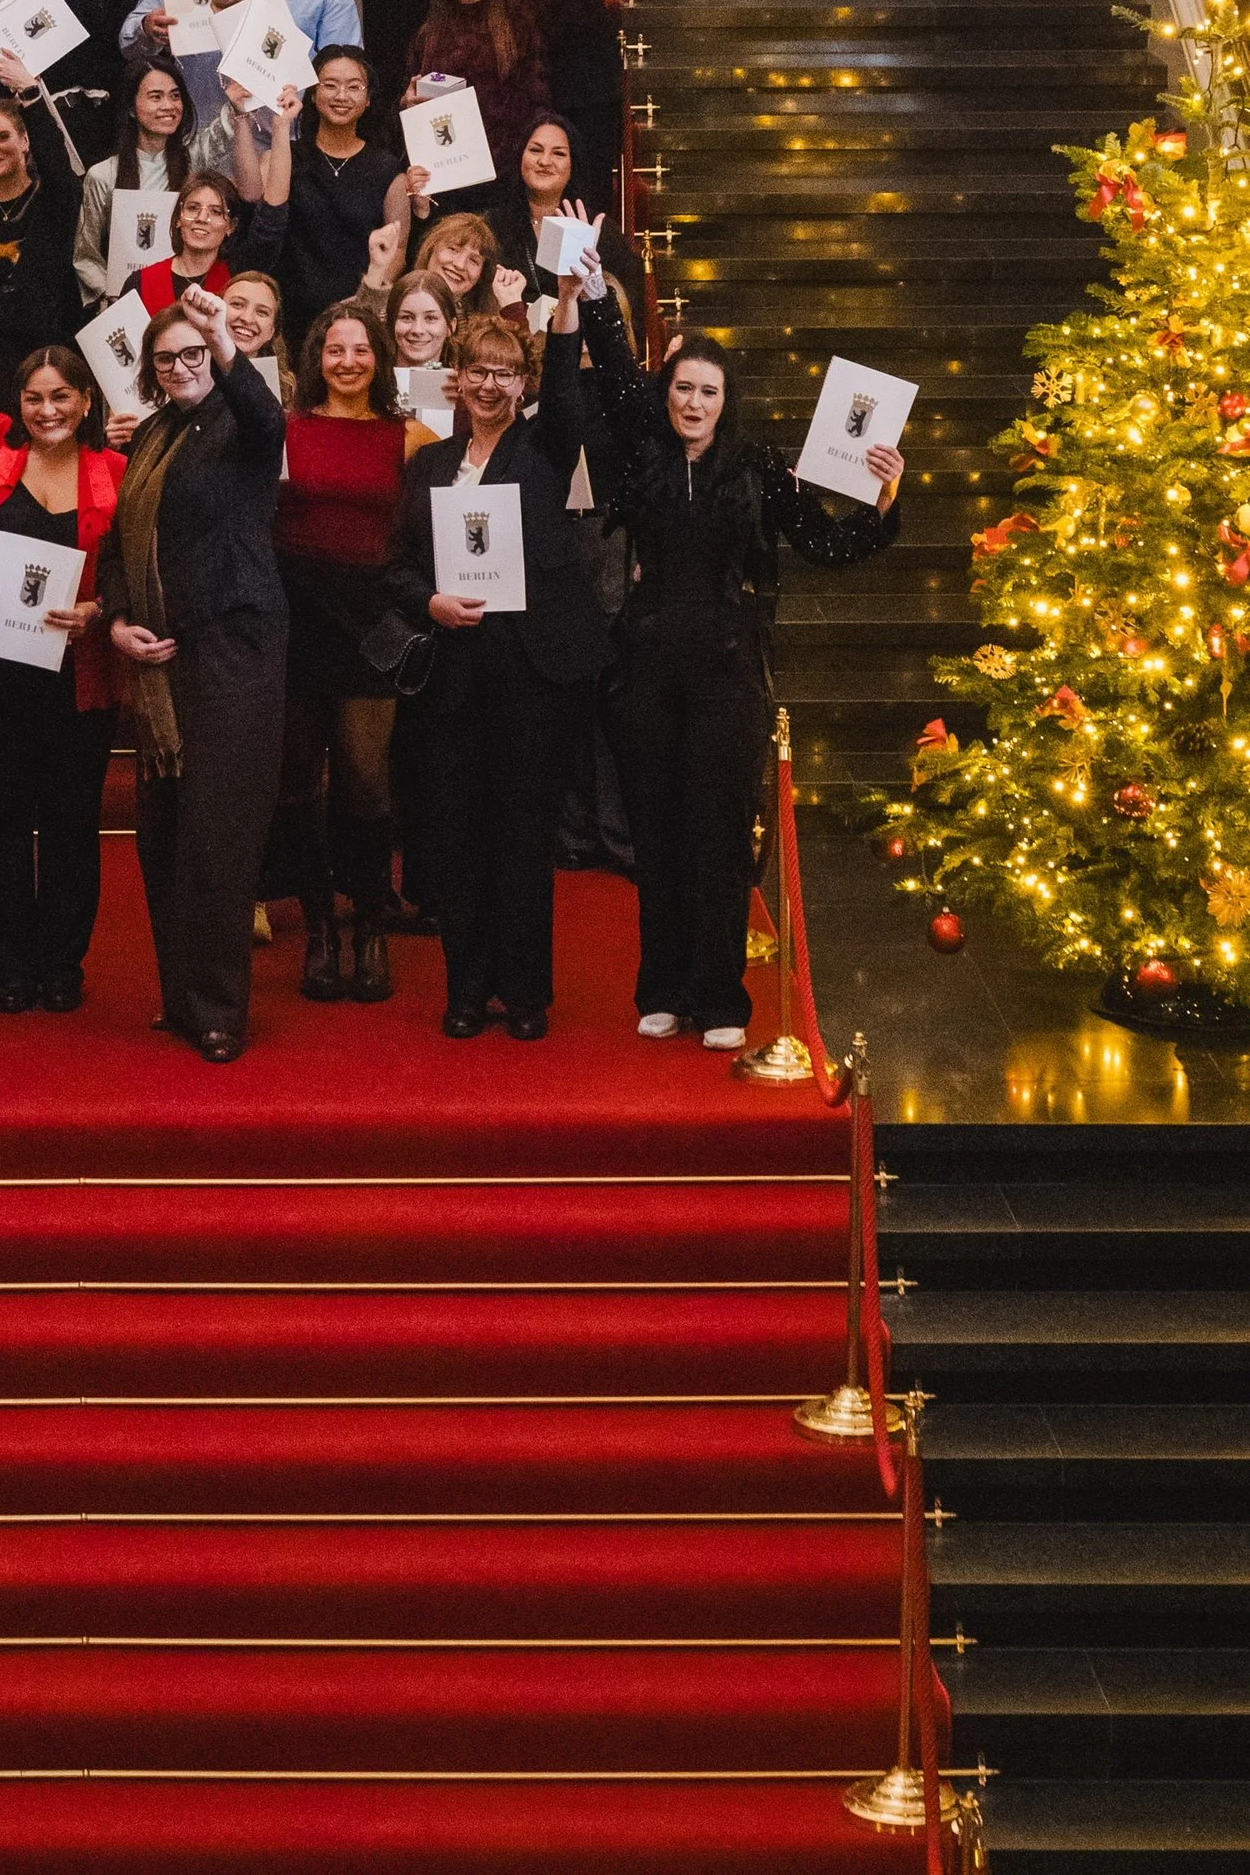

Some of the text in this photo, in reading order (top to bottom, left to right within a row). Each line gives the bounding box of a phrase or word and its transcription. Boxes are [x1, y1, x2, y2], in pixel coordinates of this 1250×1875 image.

[1, 27, 25, 60] BERLIN
[246, 57, 276, 81] BERLIN
[433, 153, 469, 168] BERLIN
[827, 446, 865, 466] BERLIN
[459, 571, 500, 582] BERLIN
[5, 619, 44, 634] BERLIN
